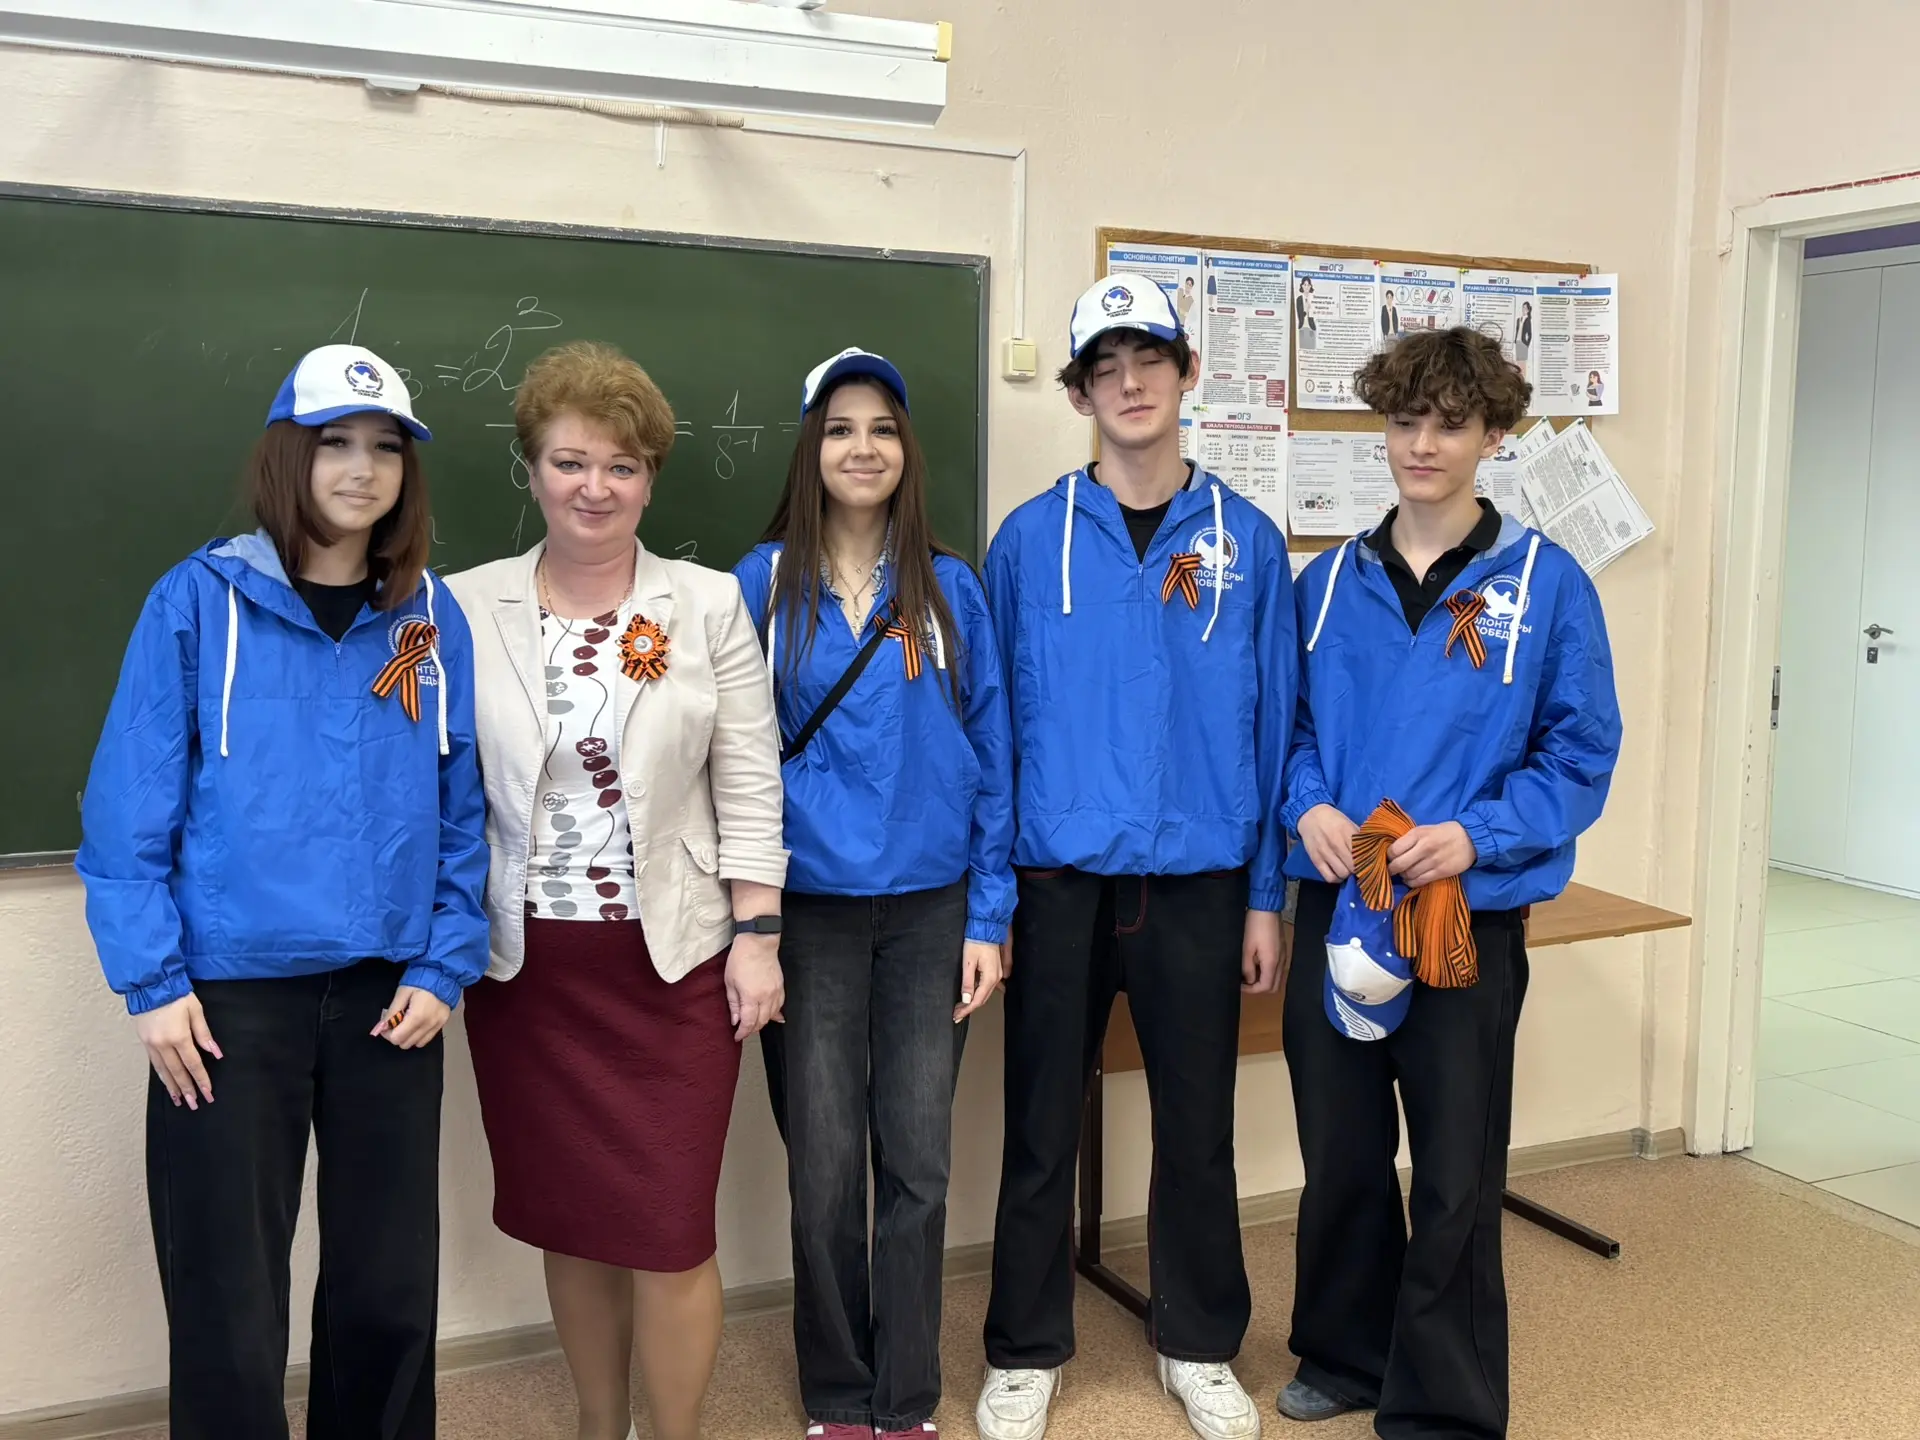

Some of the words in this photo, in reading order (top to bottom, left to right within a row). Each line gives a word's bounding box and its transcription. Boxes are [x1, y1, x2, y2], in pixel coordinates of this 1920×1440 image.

[1123, 253, 1157, 262] ОСНОВНЫЕ
[1158, 255, 1186, 263] ПОНЯТИЯ
[1328, 263, 1344, 272] ОГЭ
[1412, 269, 1427, 278] ОГЭ
[1497, 277, 1510, 285] ОГЭ
[1566, 279, 1579, 287] ОГЭ
[725, 389, 739, 425] 1
[1236, 412, 1252, 421] ОГЭ
